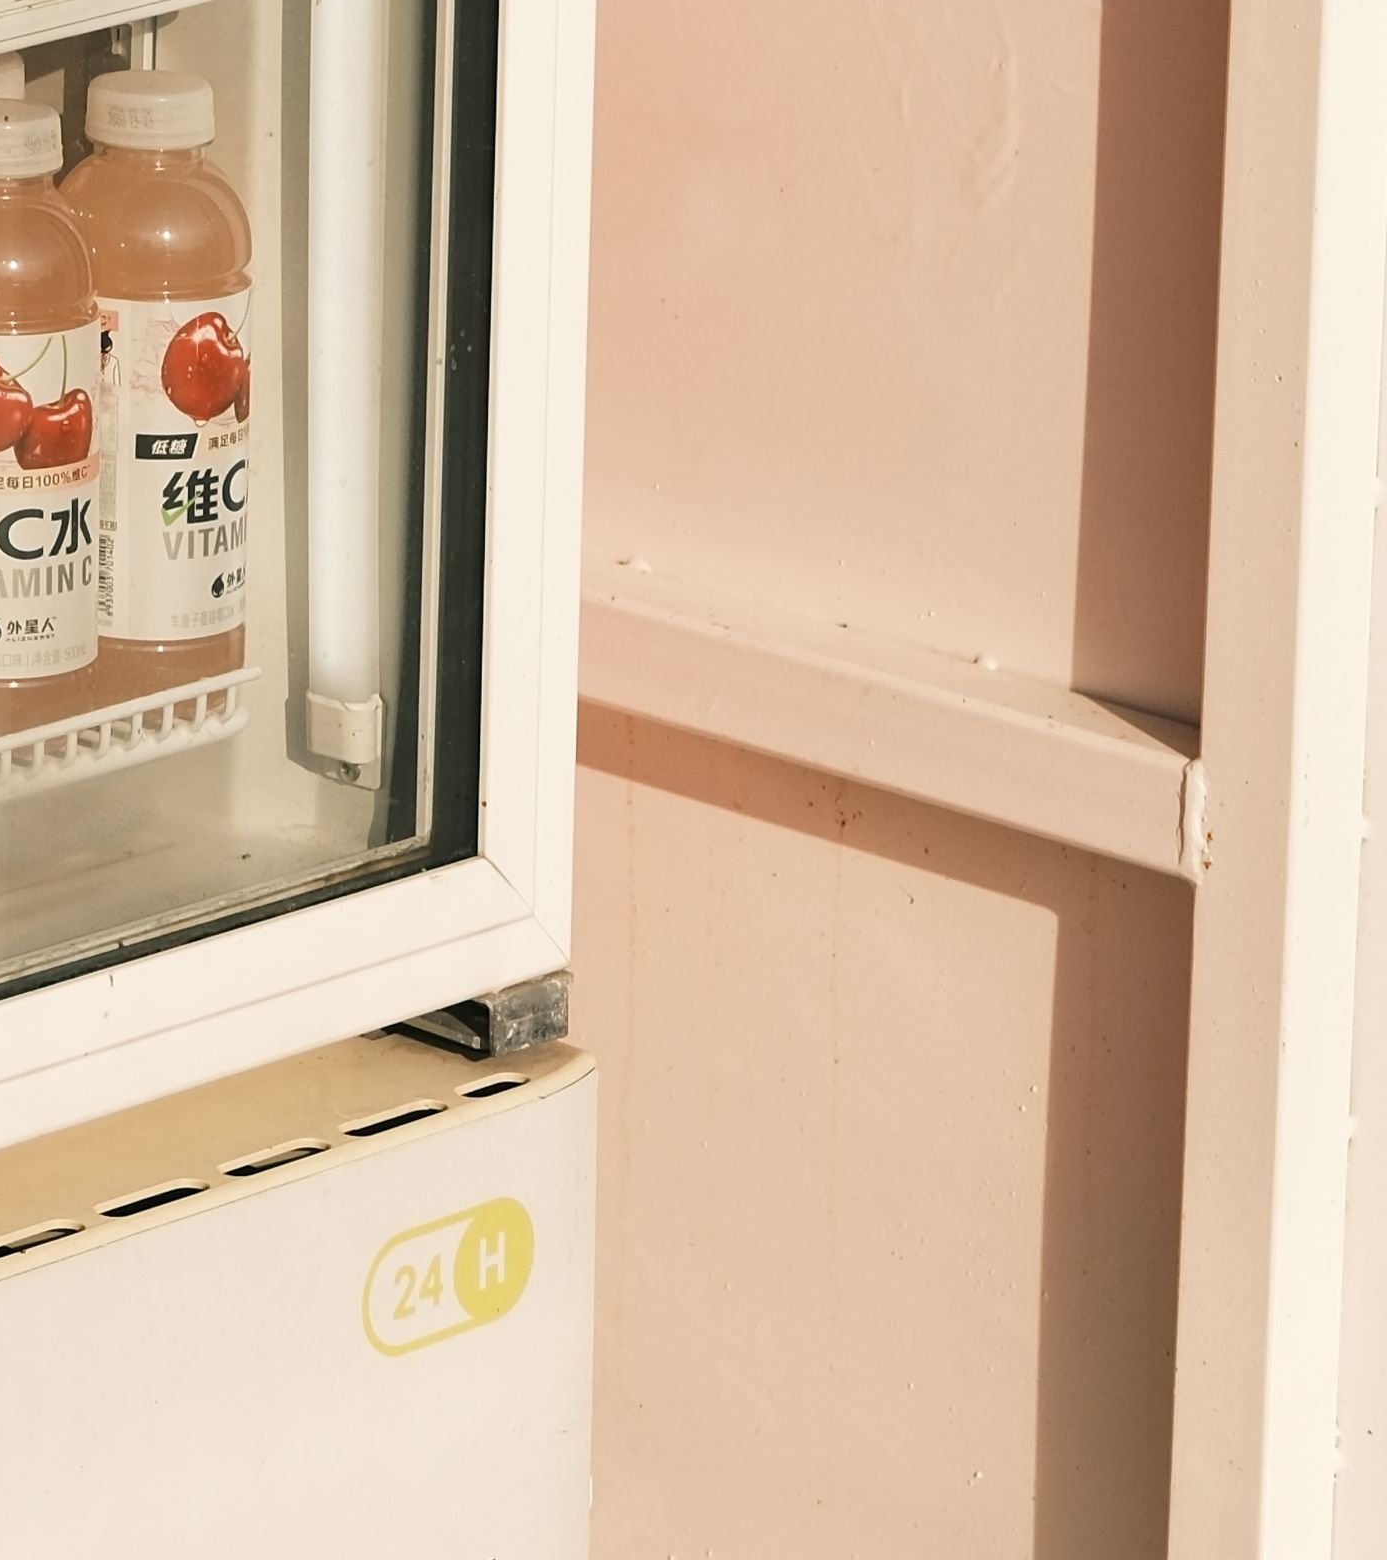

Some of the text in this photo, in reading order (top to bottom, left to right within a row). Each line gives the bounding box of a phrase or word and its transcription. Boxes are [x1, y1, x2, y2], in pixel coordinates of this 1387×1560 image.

[151, 438, 187, 456] 低糖
[6, 617, 56, 636] 外星人
[392, 1230, 507, 1321] 24 H
